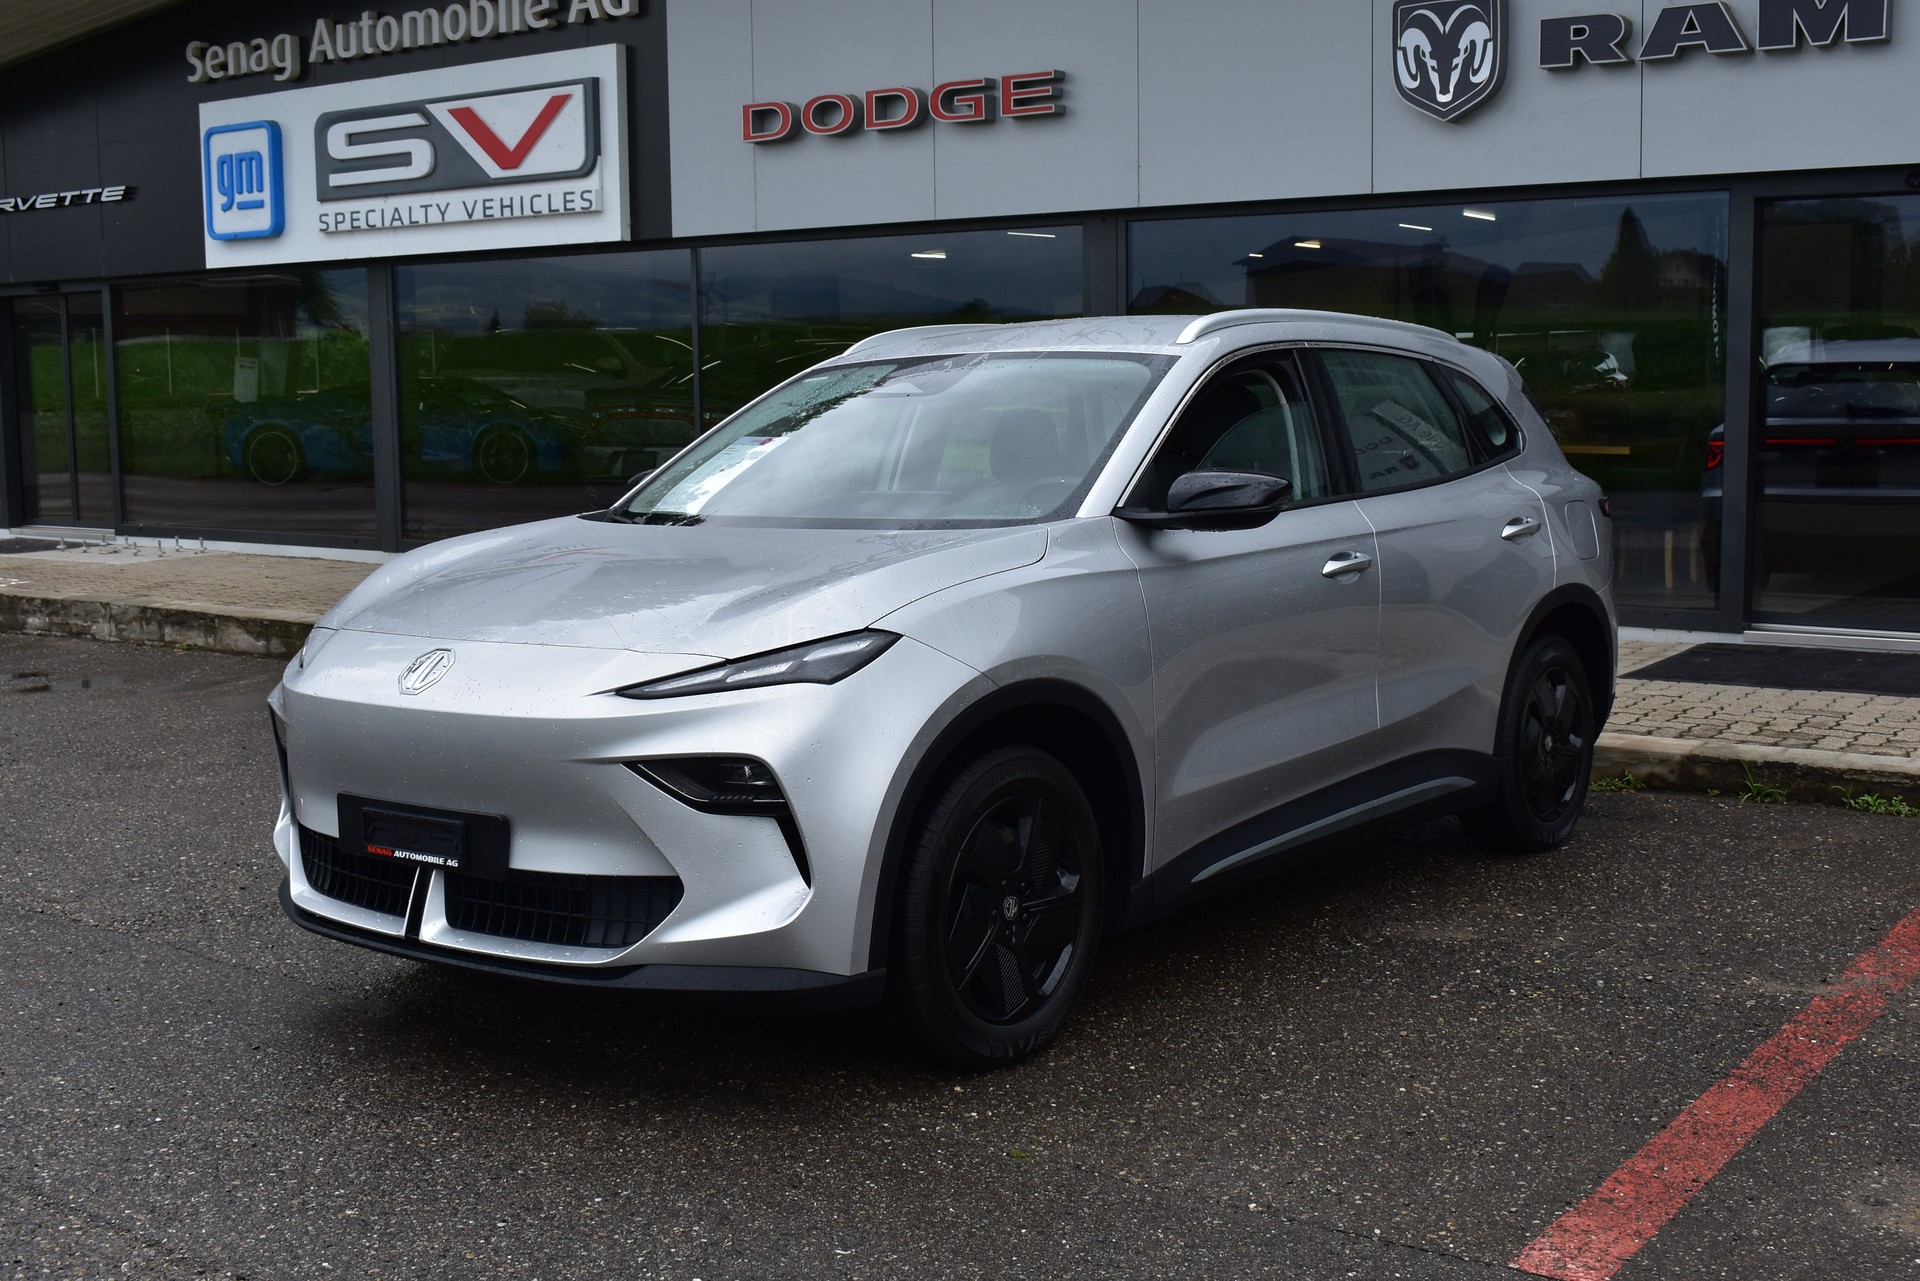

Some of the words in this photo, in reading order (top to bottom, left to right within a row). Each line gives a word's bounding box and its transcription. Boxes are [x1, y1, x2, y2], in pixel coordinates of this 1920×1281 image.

[186, 33, 297, 83] Senag
[308, 0, 549, 63] Automobile
[1539, 0, 1888, 67] RAM
[743, 70, 1060, 142] DODGE
[216, 150, 264, 212] gm
[319, 202, 450, 232] SPECIALTY
[462, 189, 594, 220] VEHICLES
[367, 845, 392, 857] SENAG
[393, 850, 445, 866] AUTOMOBILE
[446, 859, 459, 868] AG
